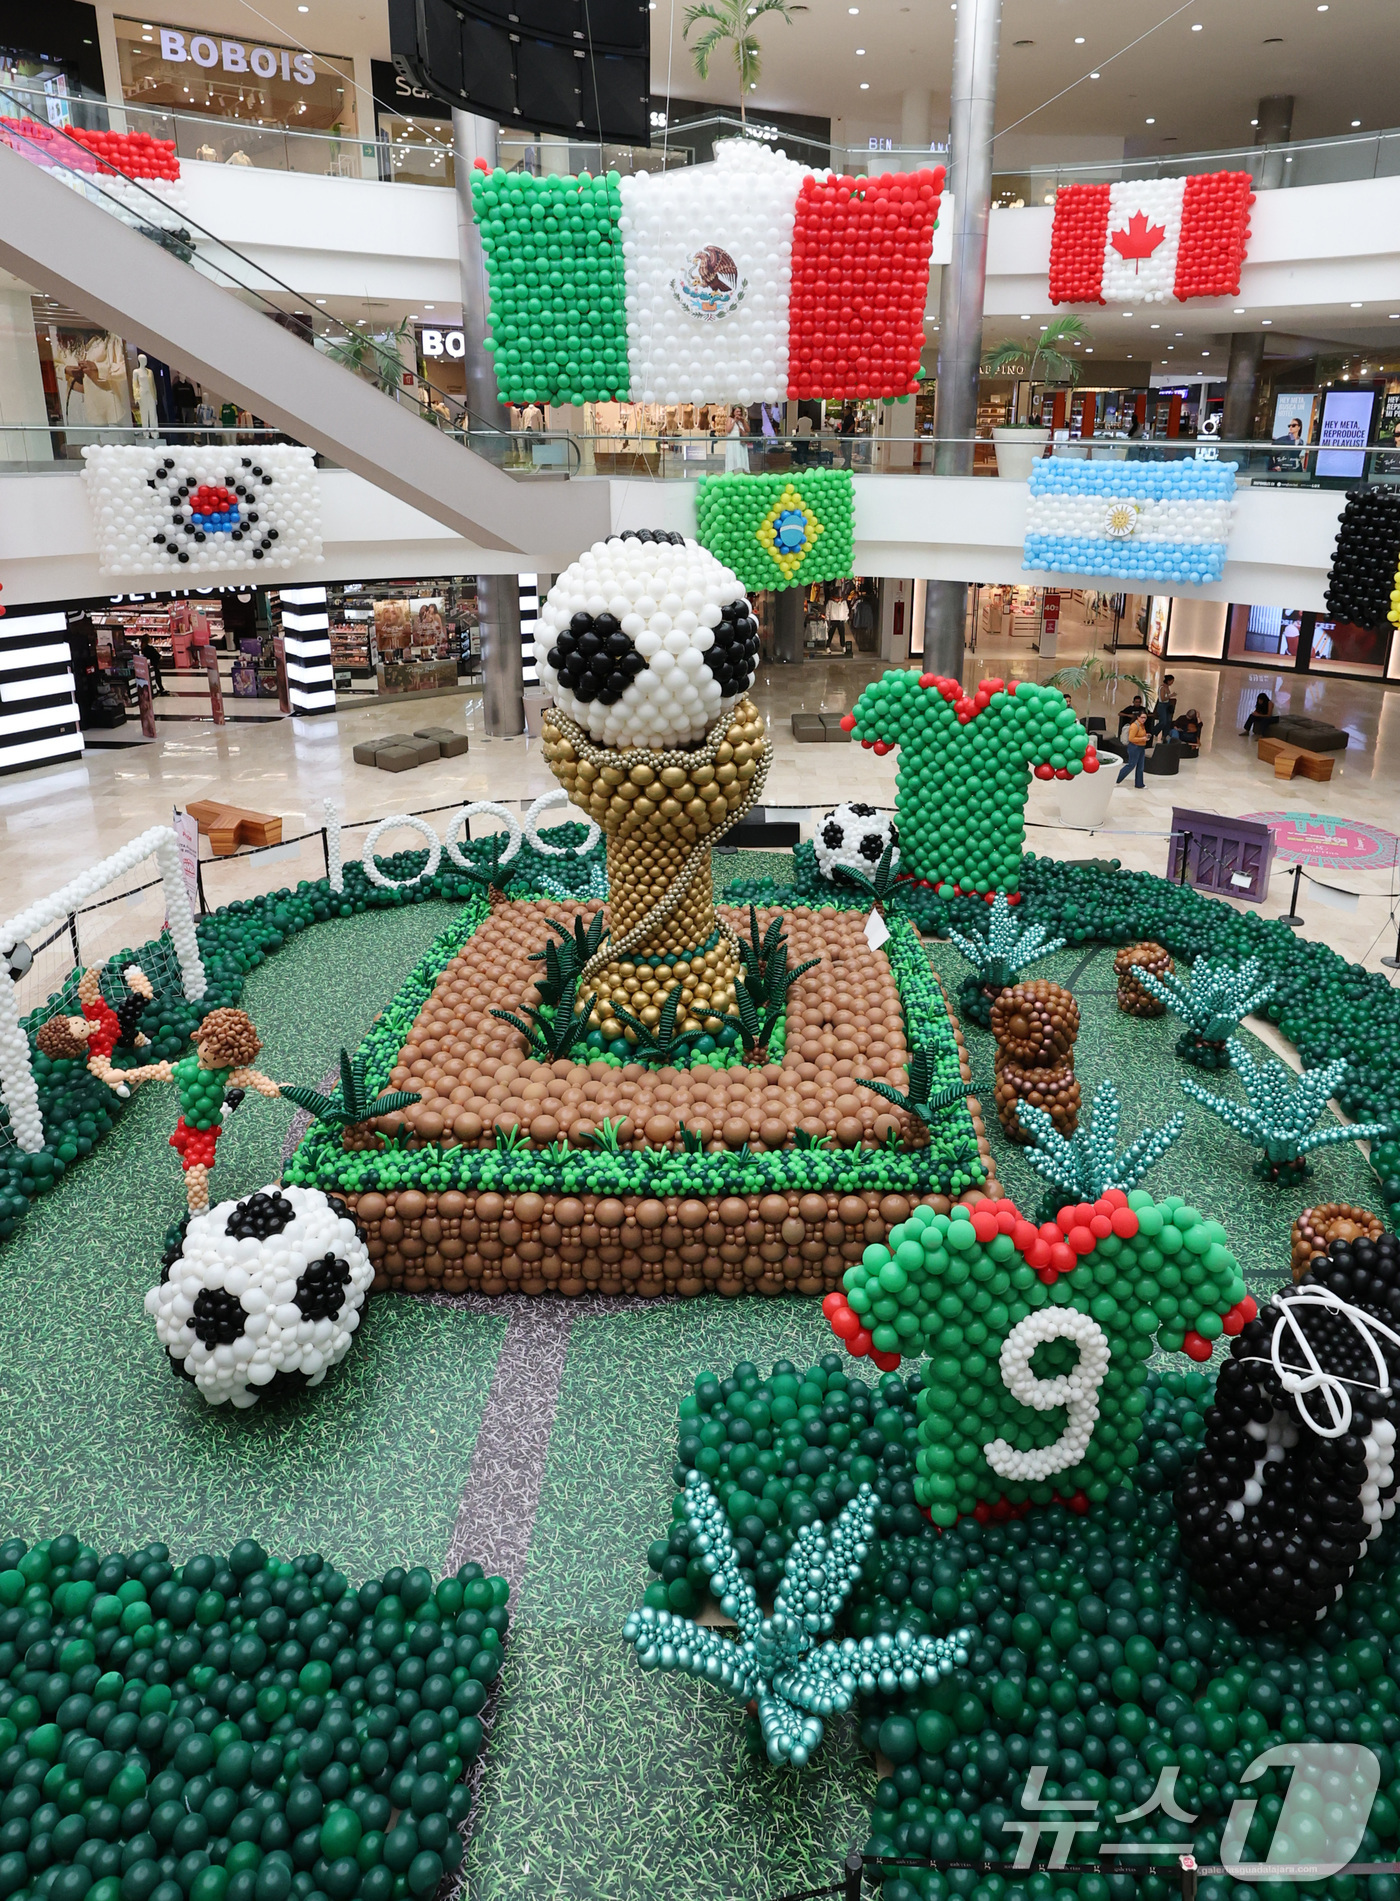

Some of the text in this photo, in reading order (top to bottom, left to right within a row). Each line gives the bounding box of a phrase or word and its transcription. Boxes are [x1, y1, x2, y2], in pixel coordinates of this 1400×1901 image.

[160, 29, 316, 85] BOBOIS
[395, 75, 430, 99] Sa
[422, 329, 466, 358] BO
[1323, 429, 1366, 438] REPRODUCE
[1324, 421, 1360, 430] HEY META,
[1321, 439, 1365, 448] MI PLAYLIST
[983, 1306, 1111, 1482] 9
